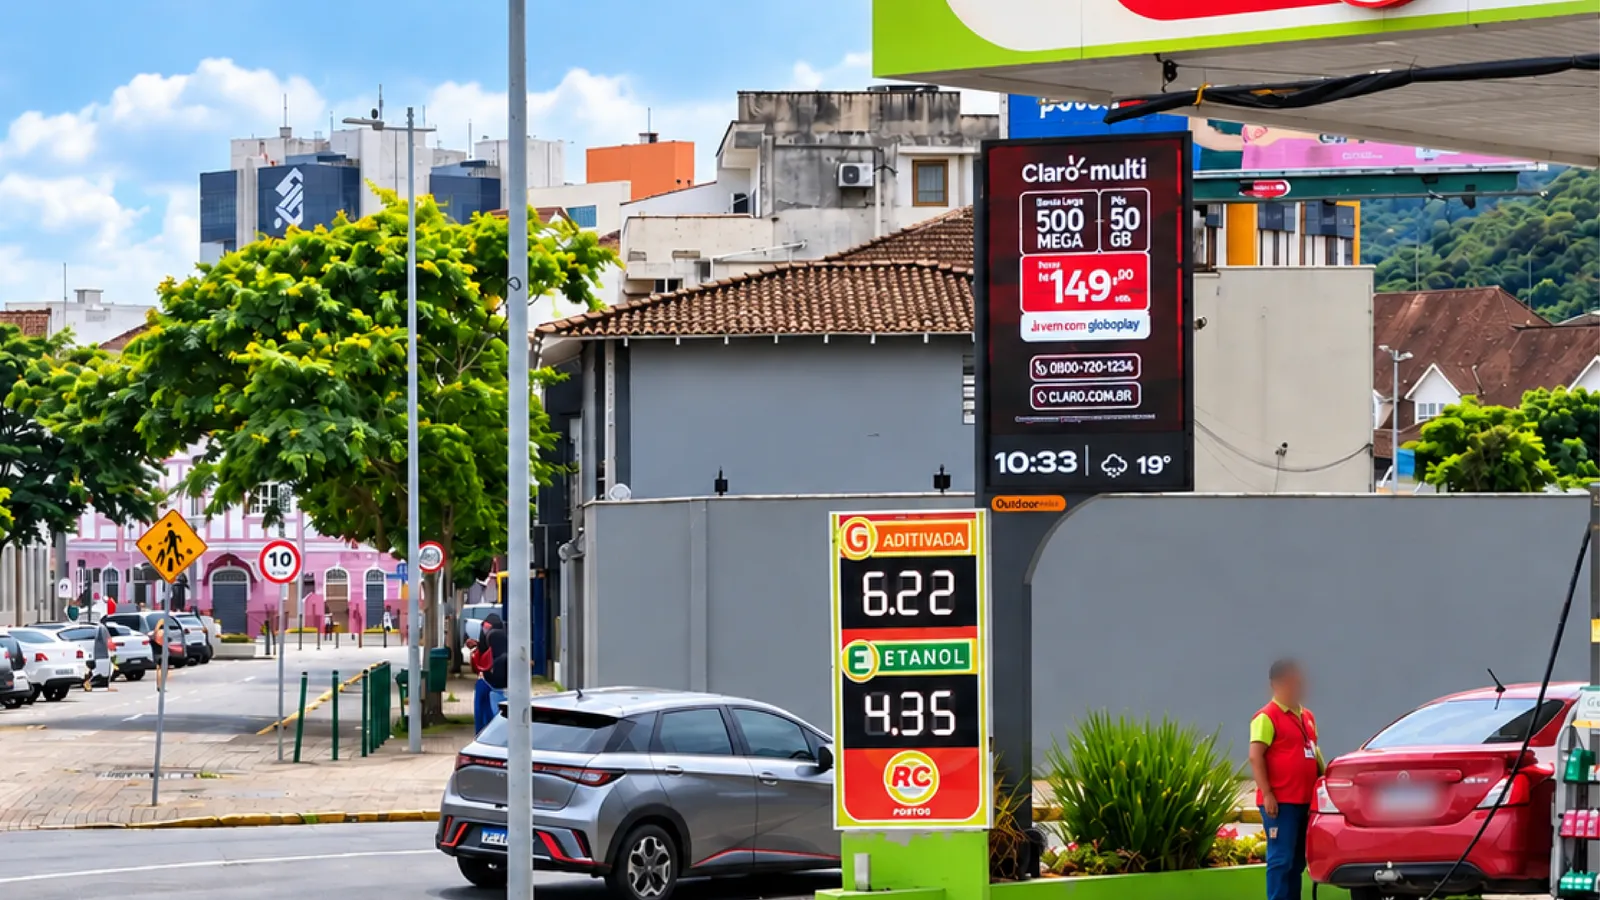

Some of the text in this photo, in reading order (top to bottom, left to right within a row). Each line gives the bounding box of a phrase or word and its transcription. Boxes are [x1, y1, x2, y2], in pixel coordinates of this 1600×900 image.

[1036, 208, 1085, 233] 500
[1110, 207, 1141, 231] 50
[1037, 233, 1084, 249] MEGA
[1110, 231, 1132, 248] GB
[1087, 319, 1141, 334] globoplay
[1048, 389, 1132, 403] CLARO.COM.BR
[993, 450, 1078, 474] 10:33
[1136, 454, 1172, 475] 19°
[883, 532, 965, 547] ADITIVADA
[268, 551, 292, 568] 10
[862, 569, 955, 617] 6.22
[884, 648, 965, 667] ETANOL
[864, 690, 956, 737] 4.35
[892, 765, 932, 788] RC
